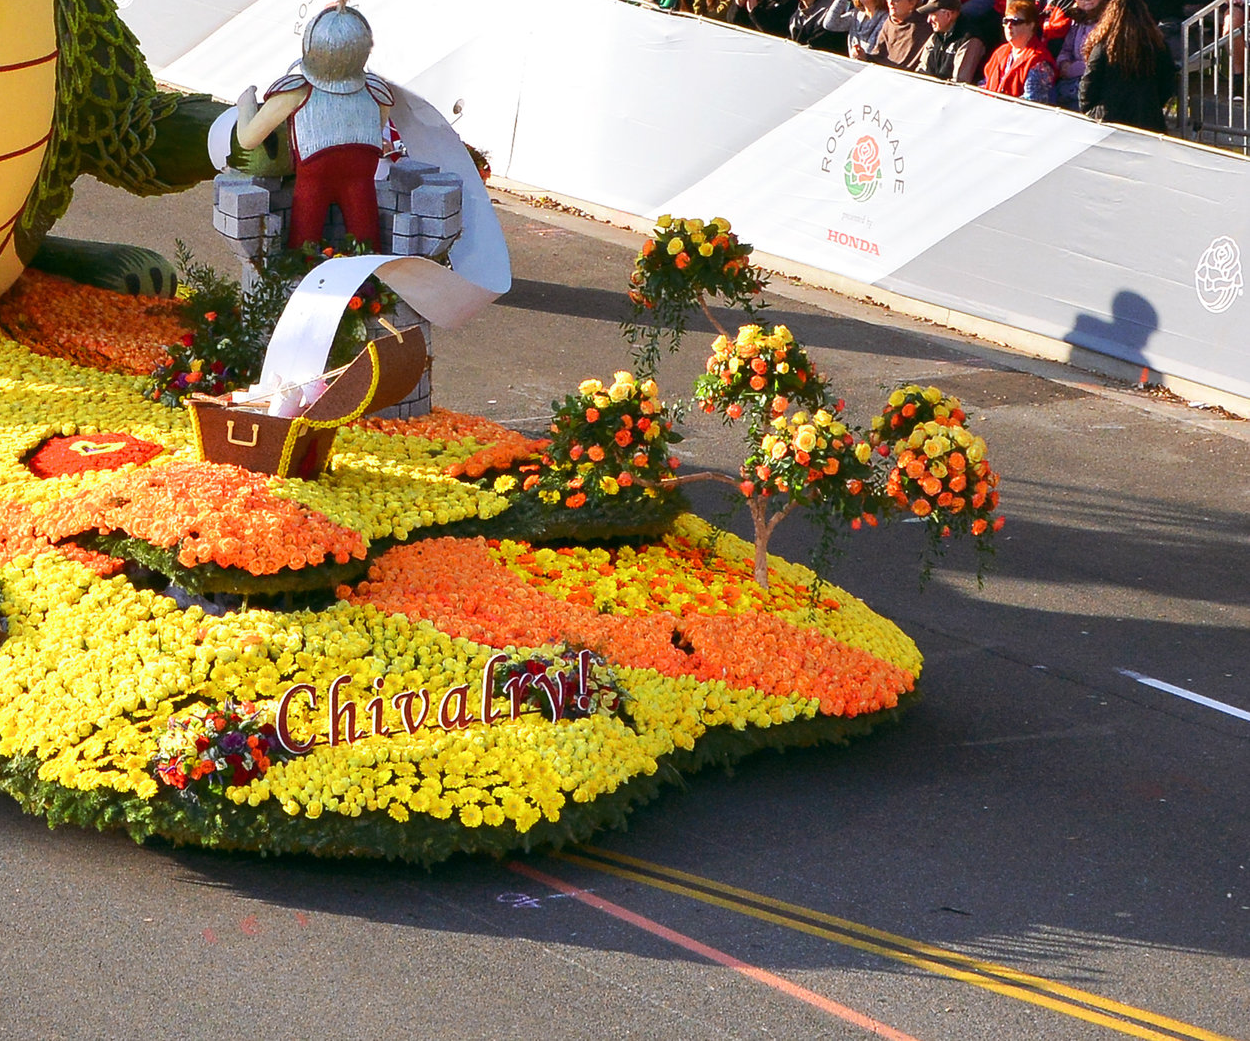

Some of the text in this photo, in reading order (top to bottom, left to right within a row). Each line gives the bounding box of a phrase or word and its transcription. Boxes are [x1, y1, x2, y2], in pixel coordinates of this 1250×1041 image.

[821, 104, 905, 195] ROSE PARADE
[827, 228, 881, 257] HONDA
[276, 649, 592, 755] Chivalry!
